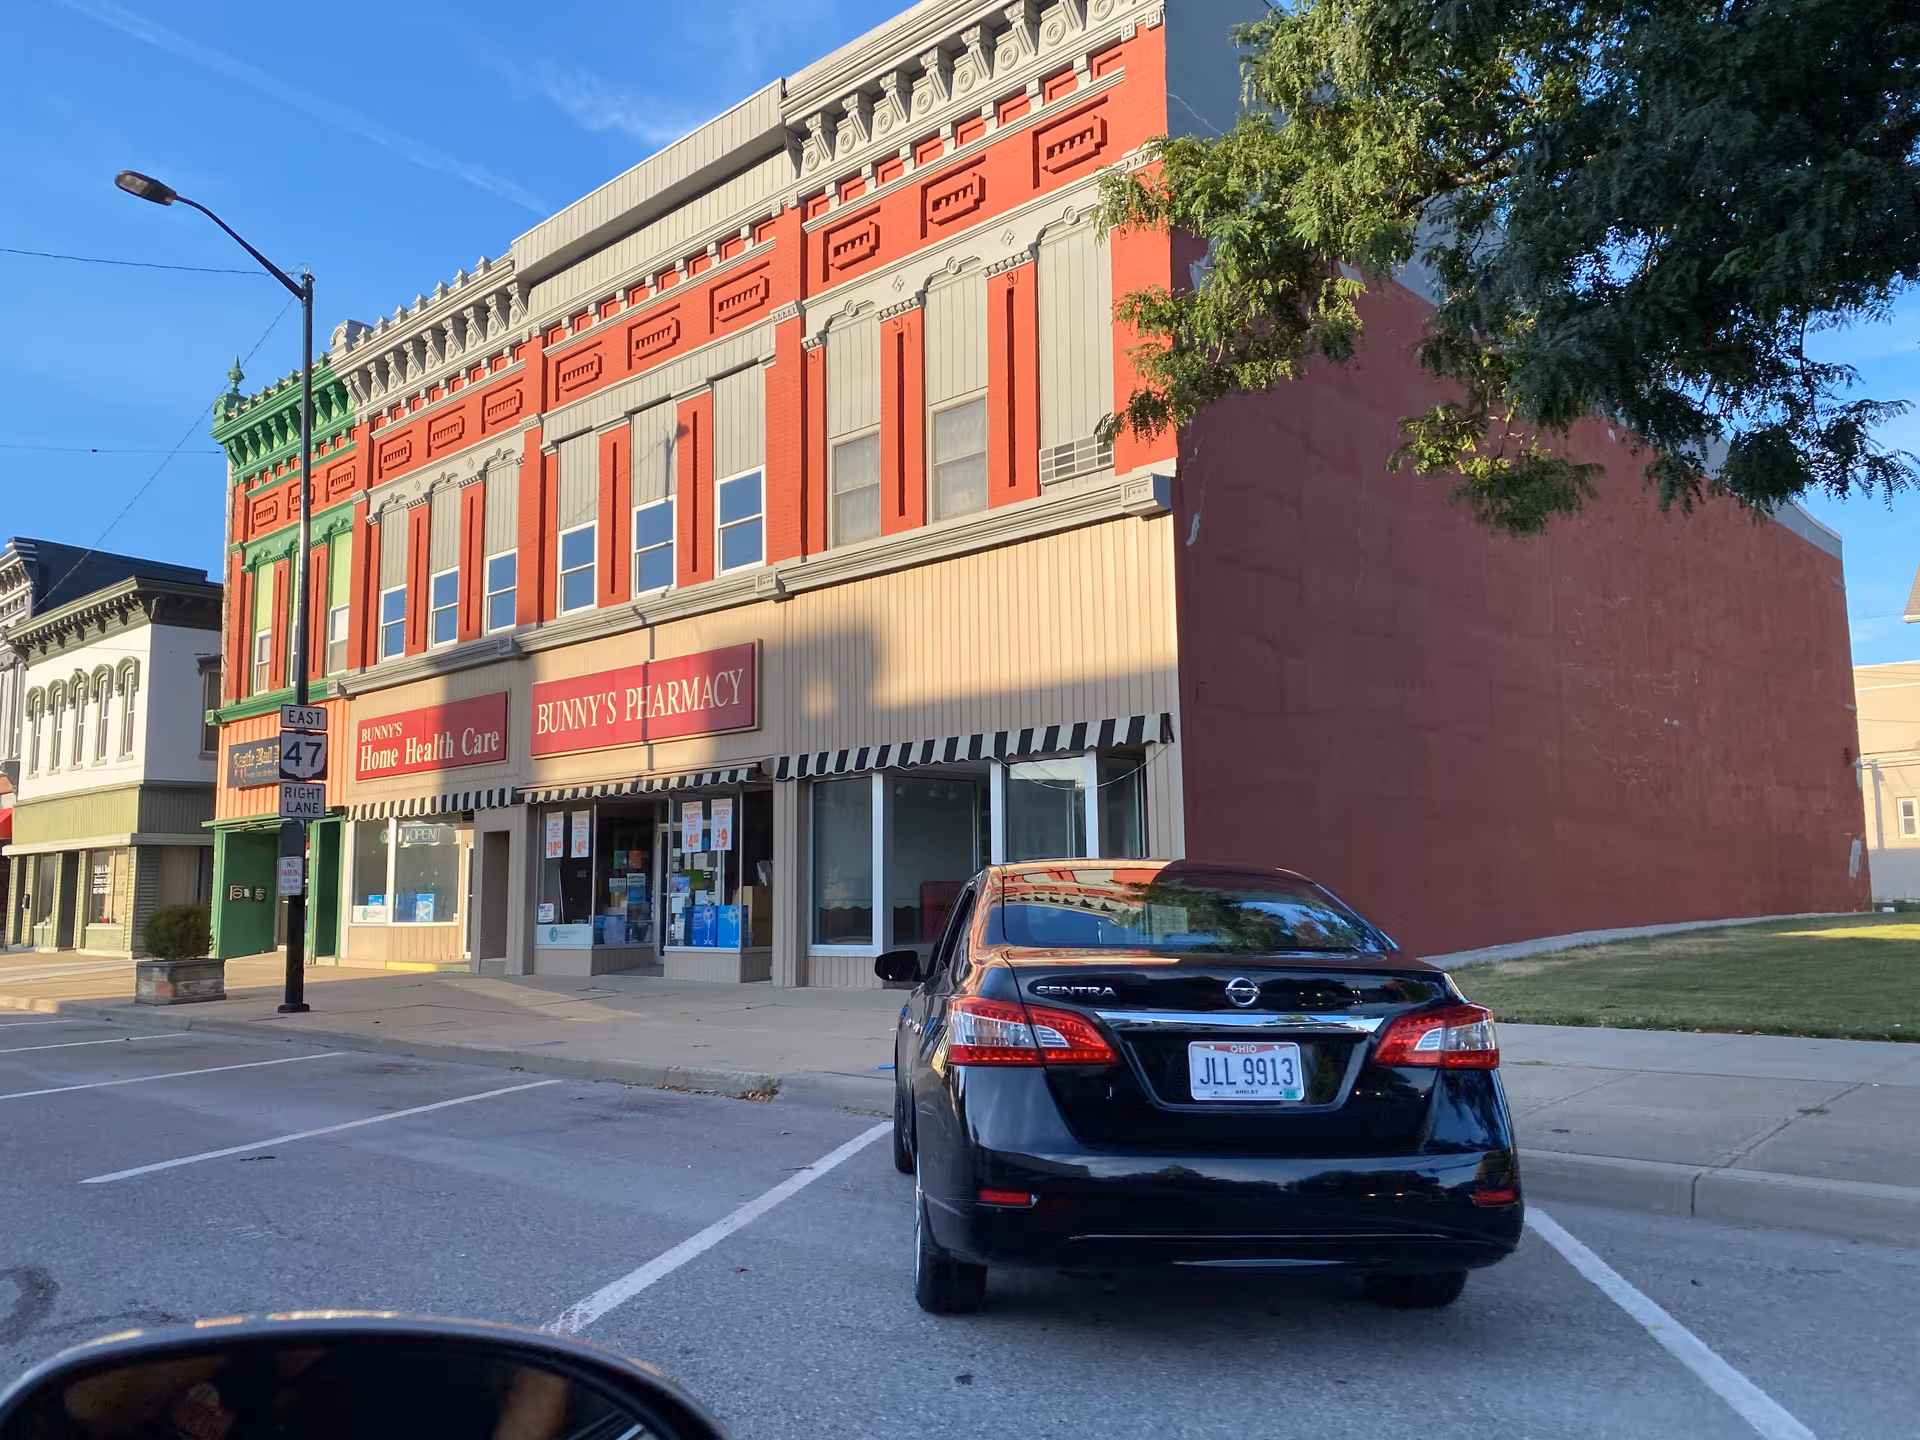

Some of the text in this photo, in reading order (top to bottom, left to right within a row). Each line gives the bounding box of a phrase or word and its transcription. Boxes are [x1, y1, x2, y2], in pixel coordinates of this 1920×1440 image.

[537, 668, 744, 735] BUNNY'S PHARMACY
[288, 710, 322, 725] EAST
[361, 721, 403, 743] BUNNY'S
[283, 741, 322, 767] 47
[360, 727, 499, 772] Home Health Care
[284, 787, 322, 800] RIGHT
[286, 801, 320, 814] LANE
[409, 828, 436, 841] OPEN
[286, 859, 296, 869] NO
[280, 869, 301, 877] PARKING
[1036, 985, 1117, 997] SENTRA
[1230, 1044, 1257, 1054] OHIO
[1200, 1057, 1294, 1086] JLL 9913
